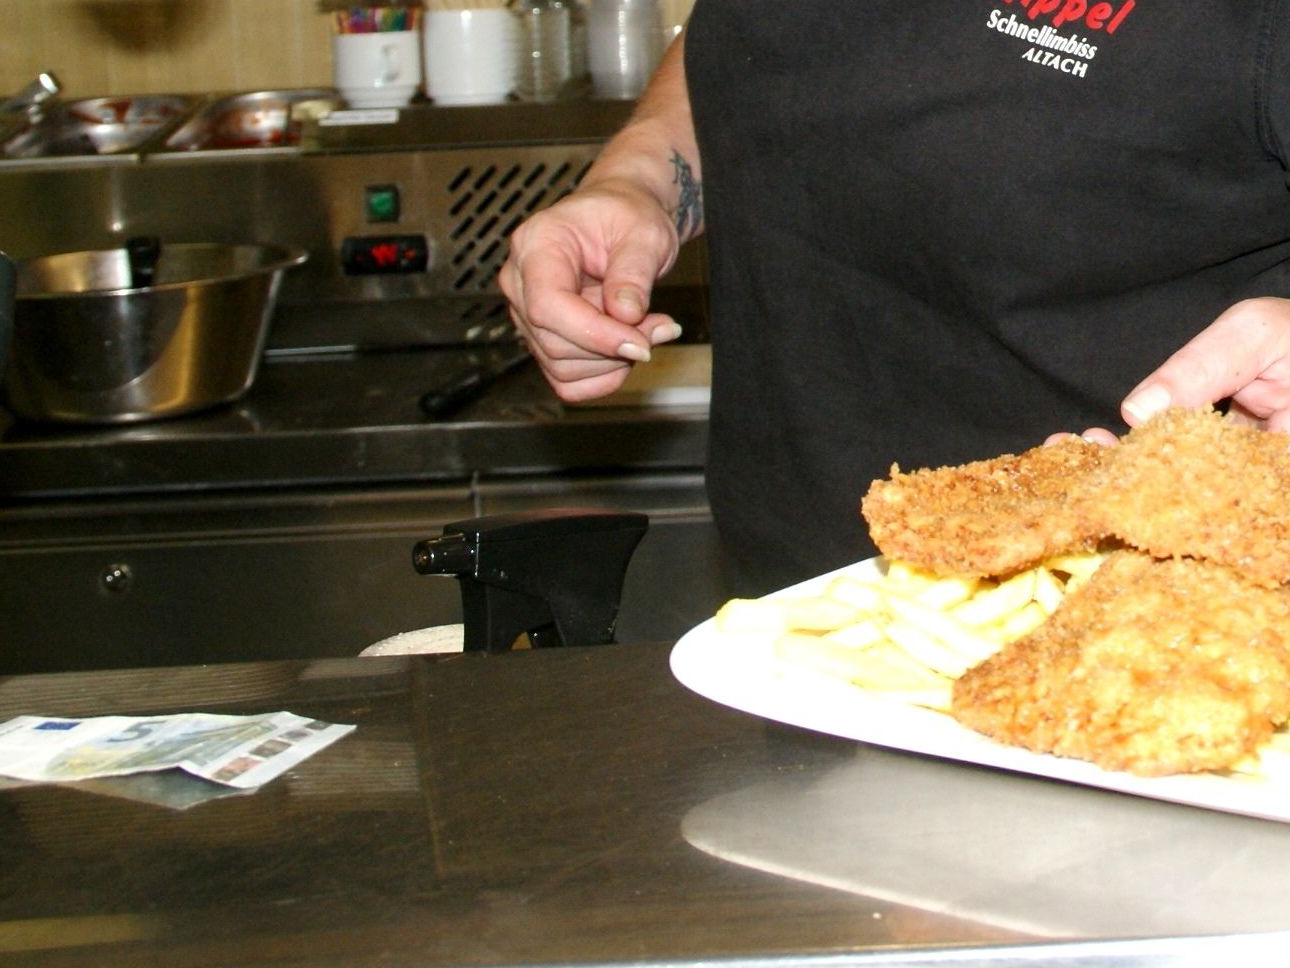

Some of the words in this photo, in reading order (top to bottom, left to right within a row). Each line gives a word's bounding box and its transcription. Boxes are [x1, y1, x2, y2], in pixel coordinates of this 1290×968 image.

[986, 9, 1098, 60] Schnellimbiss
[1021, 47, 1089, 78] ALTACH
[106, 720, 168, 742] 5
